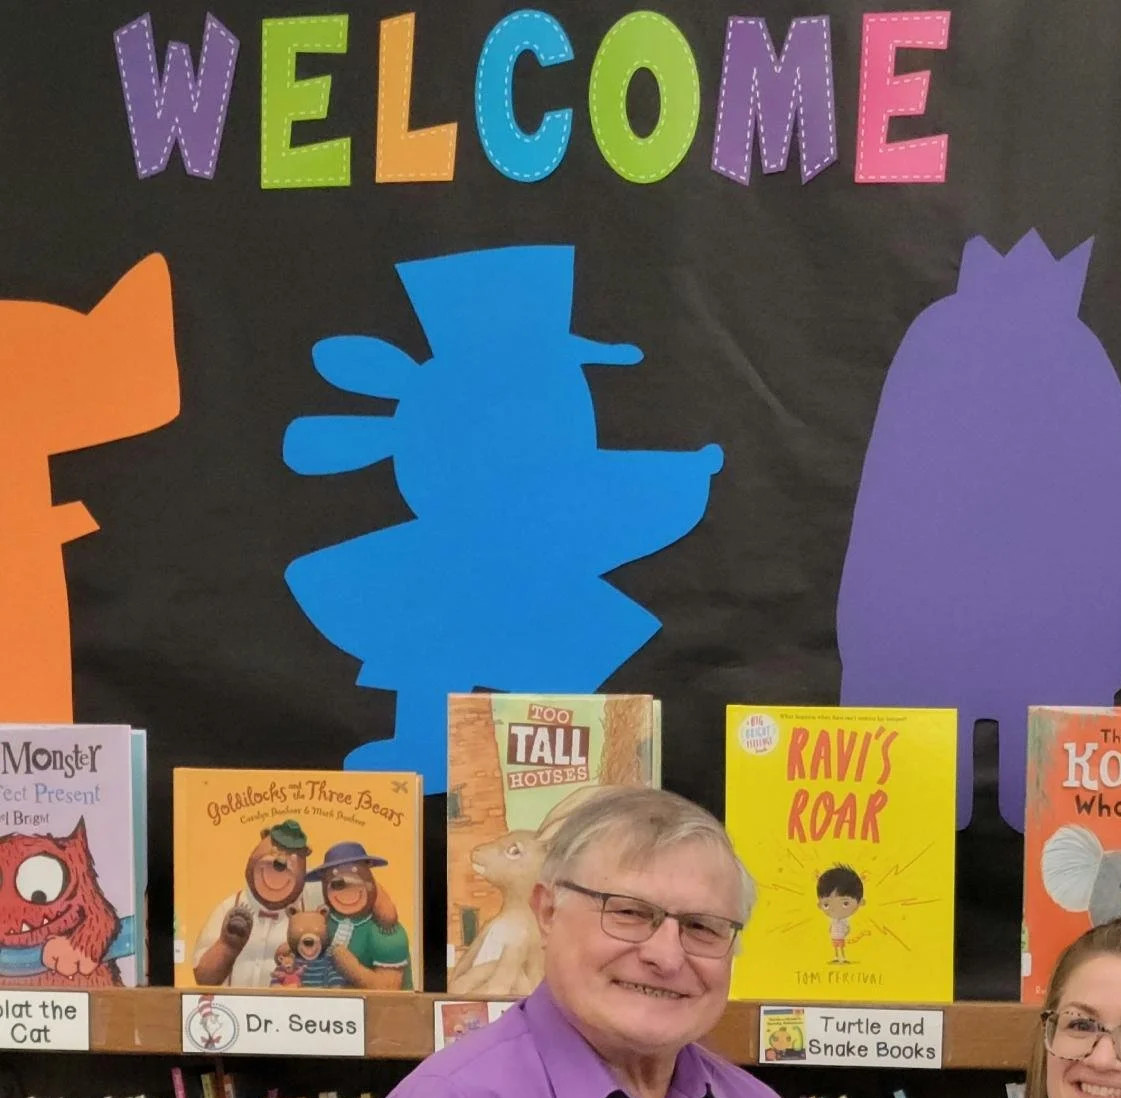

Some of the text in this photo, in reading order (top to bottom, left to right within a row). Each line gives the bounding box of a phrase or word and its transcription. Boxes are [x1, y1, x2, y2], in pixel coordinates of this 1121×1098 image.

[114, 10, 952, 187] WELCOME
[531, 705, 570, 724] TOO
[510, 725, 587, 765] TALL
[787, 726, 899, 785] RAVI'S
[1, 741, 102, 779] Monster
[509, 766, 588, 788] HOUSES
[34, 782, 100, 805] Present
[207, 781, 287, 826] Goldilocks
[305, 779, 352, 806] Three
[357, 789, 404, 828] Bears
[13, 811, 49, 826] Bright
[788, 788, 888, 844] ROAR
[795, 971, 884, 986] TOM PERCIVAL
[38, 1001, 78, 1020] the
[11, 1023, 51, 1044] Cat
[246, 1013, 358, 1036] Dr. Seuss
[820, 1015, 882, 1035] Turtle
[889, 1017, 924, 1036] and
[808, 1038, 936, 1060] Snake Books
